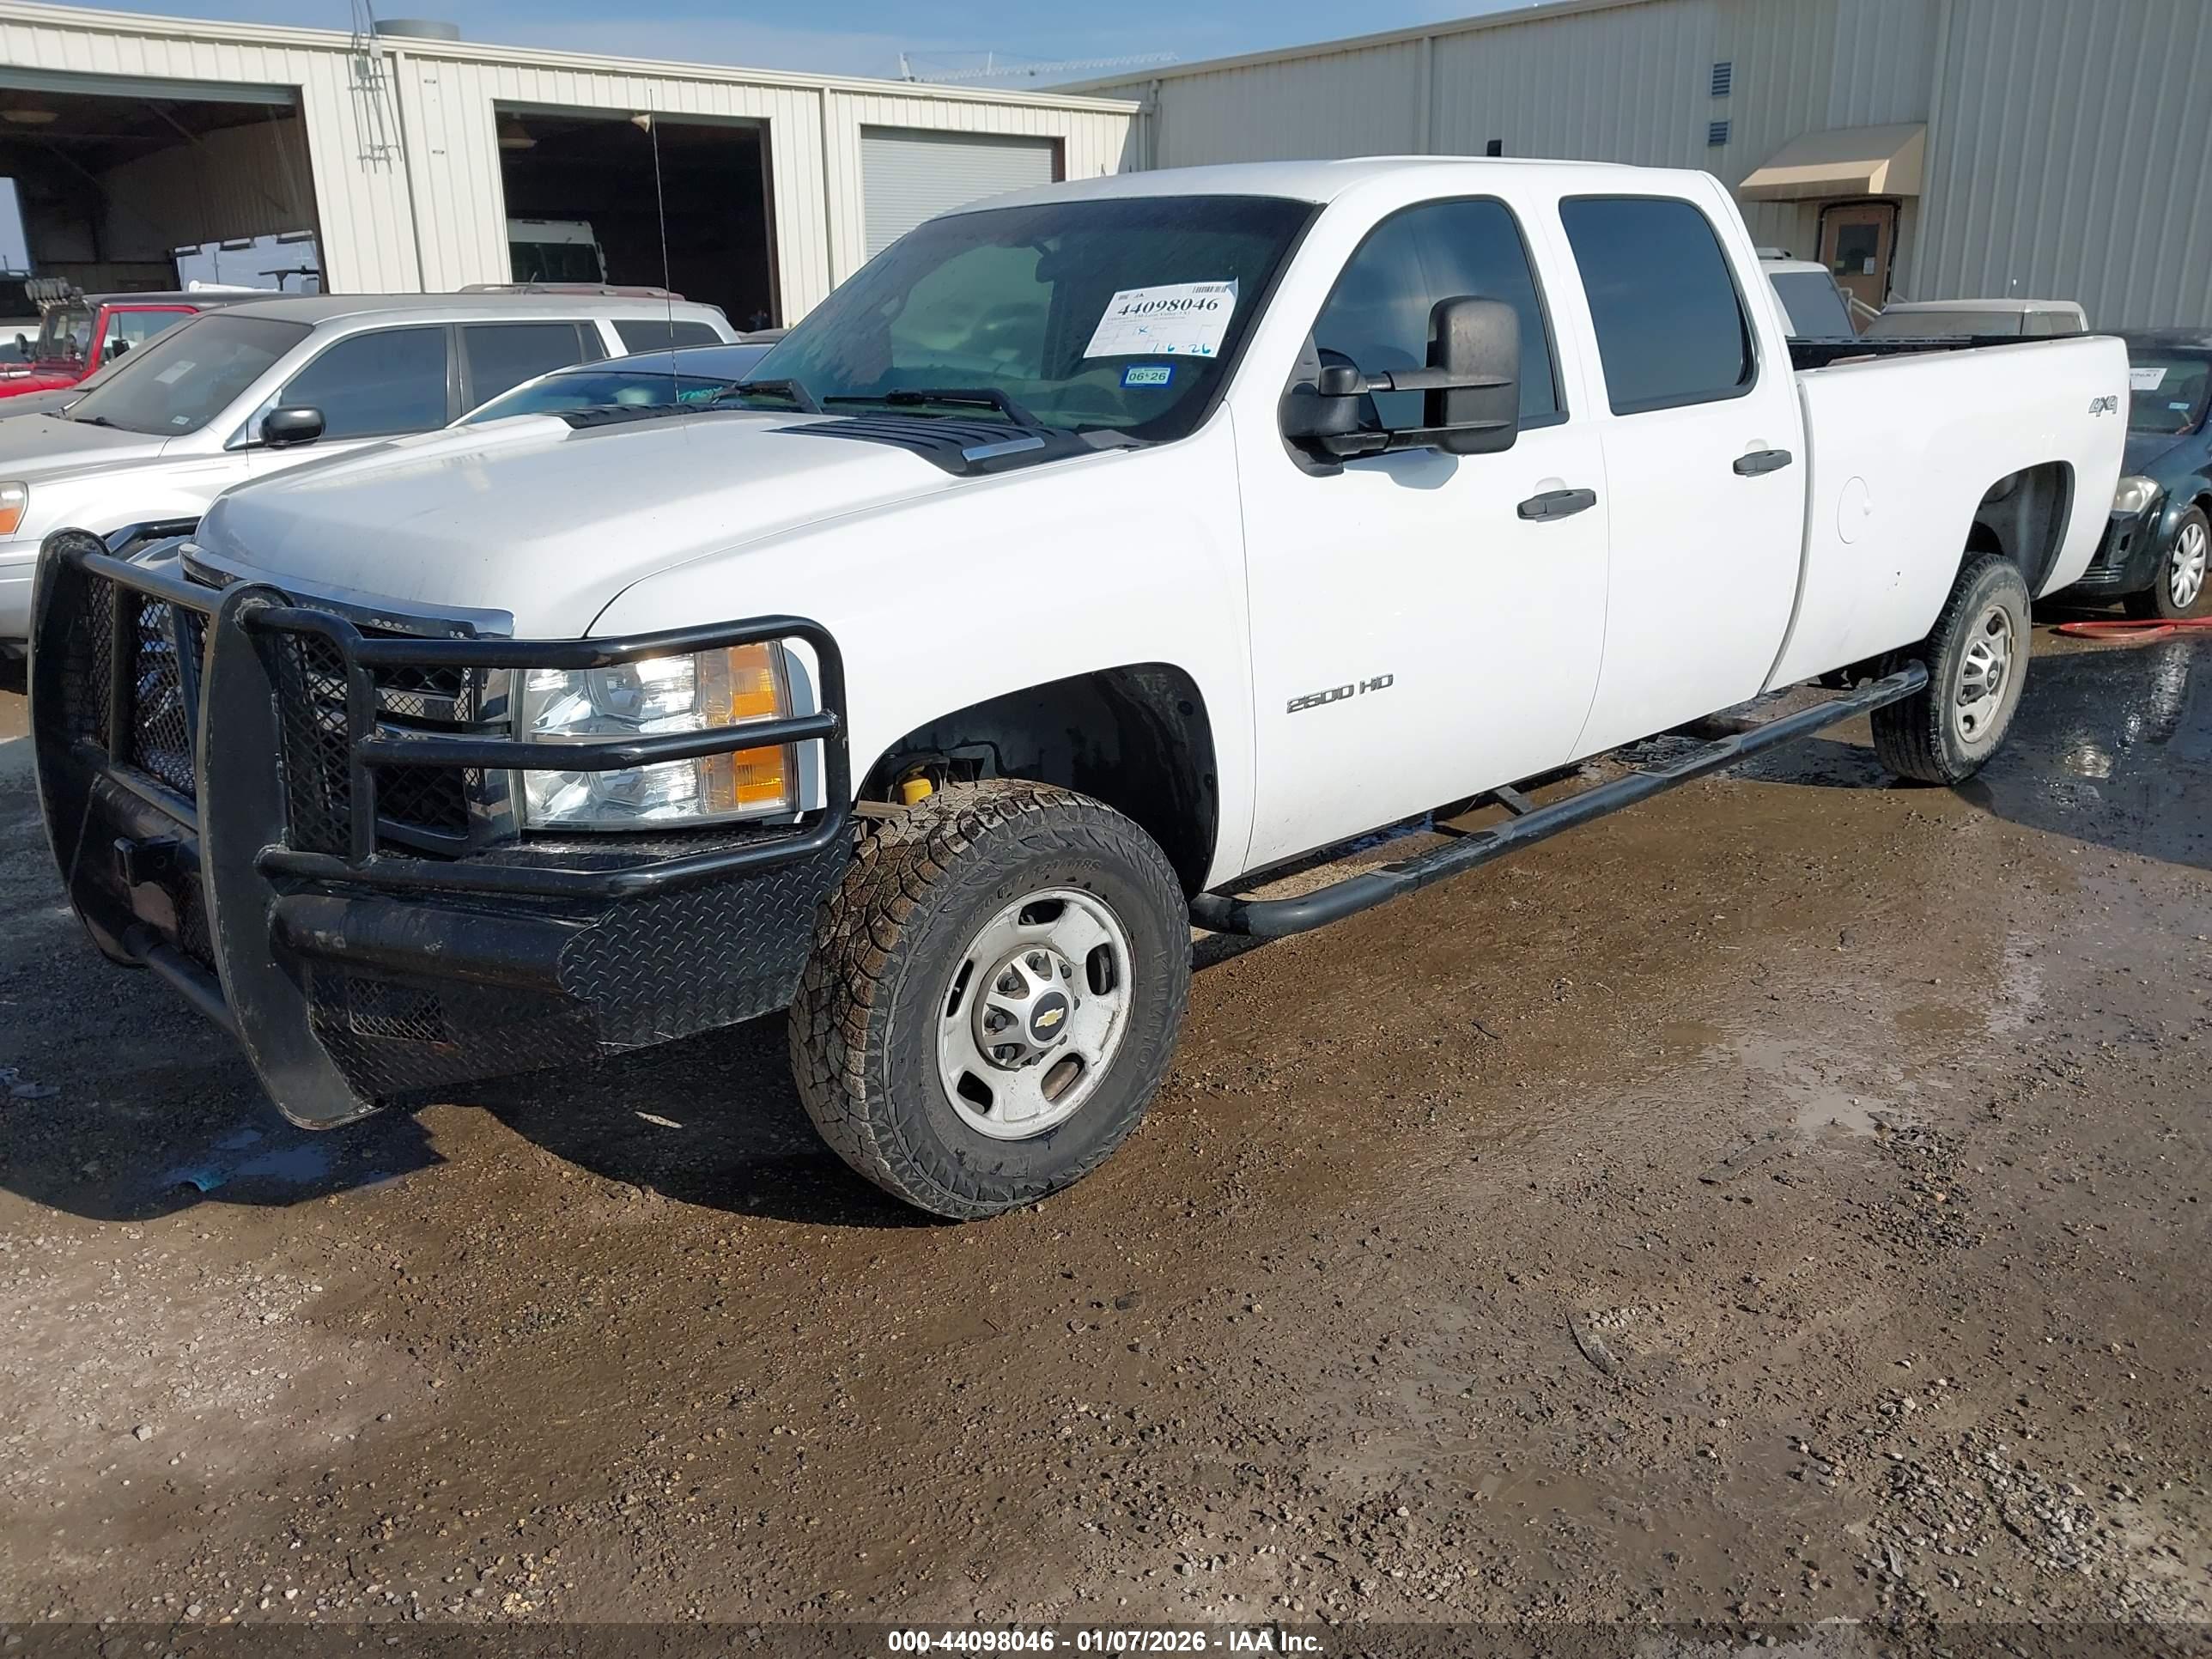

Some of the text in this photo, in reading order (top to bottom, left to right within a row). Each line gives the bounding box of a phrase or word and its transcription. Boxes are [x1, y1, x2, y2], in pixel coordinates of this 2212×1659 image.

[1117, 297, 1220, 316] 44098046
[1128, 372, 1167, 381] 06 26
[1286, 673, 1394, 714] 2500 HD
